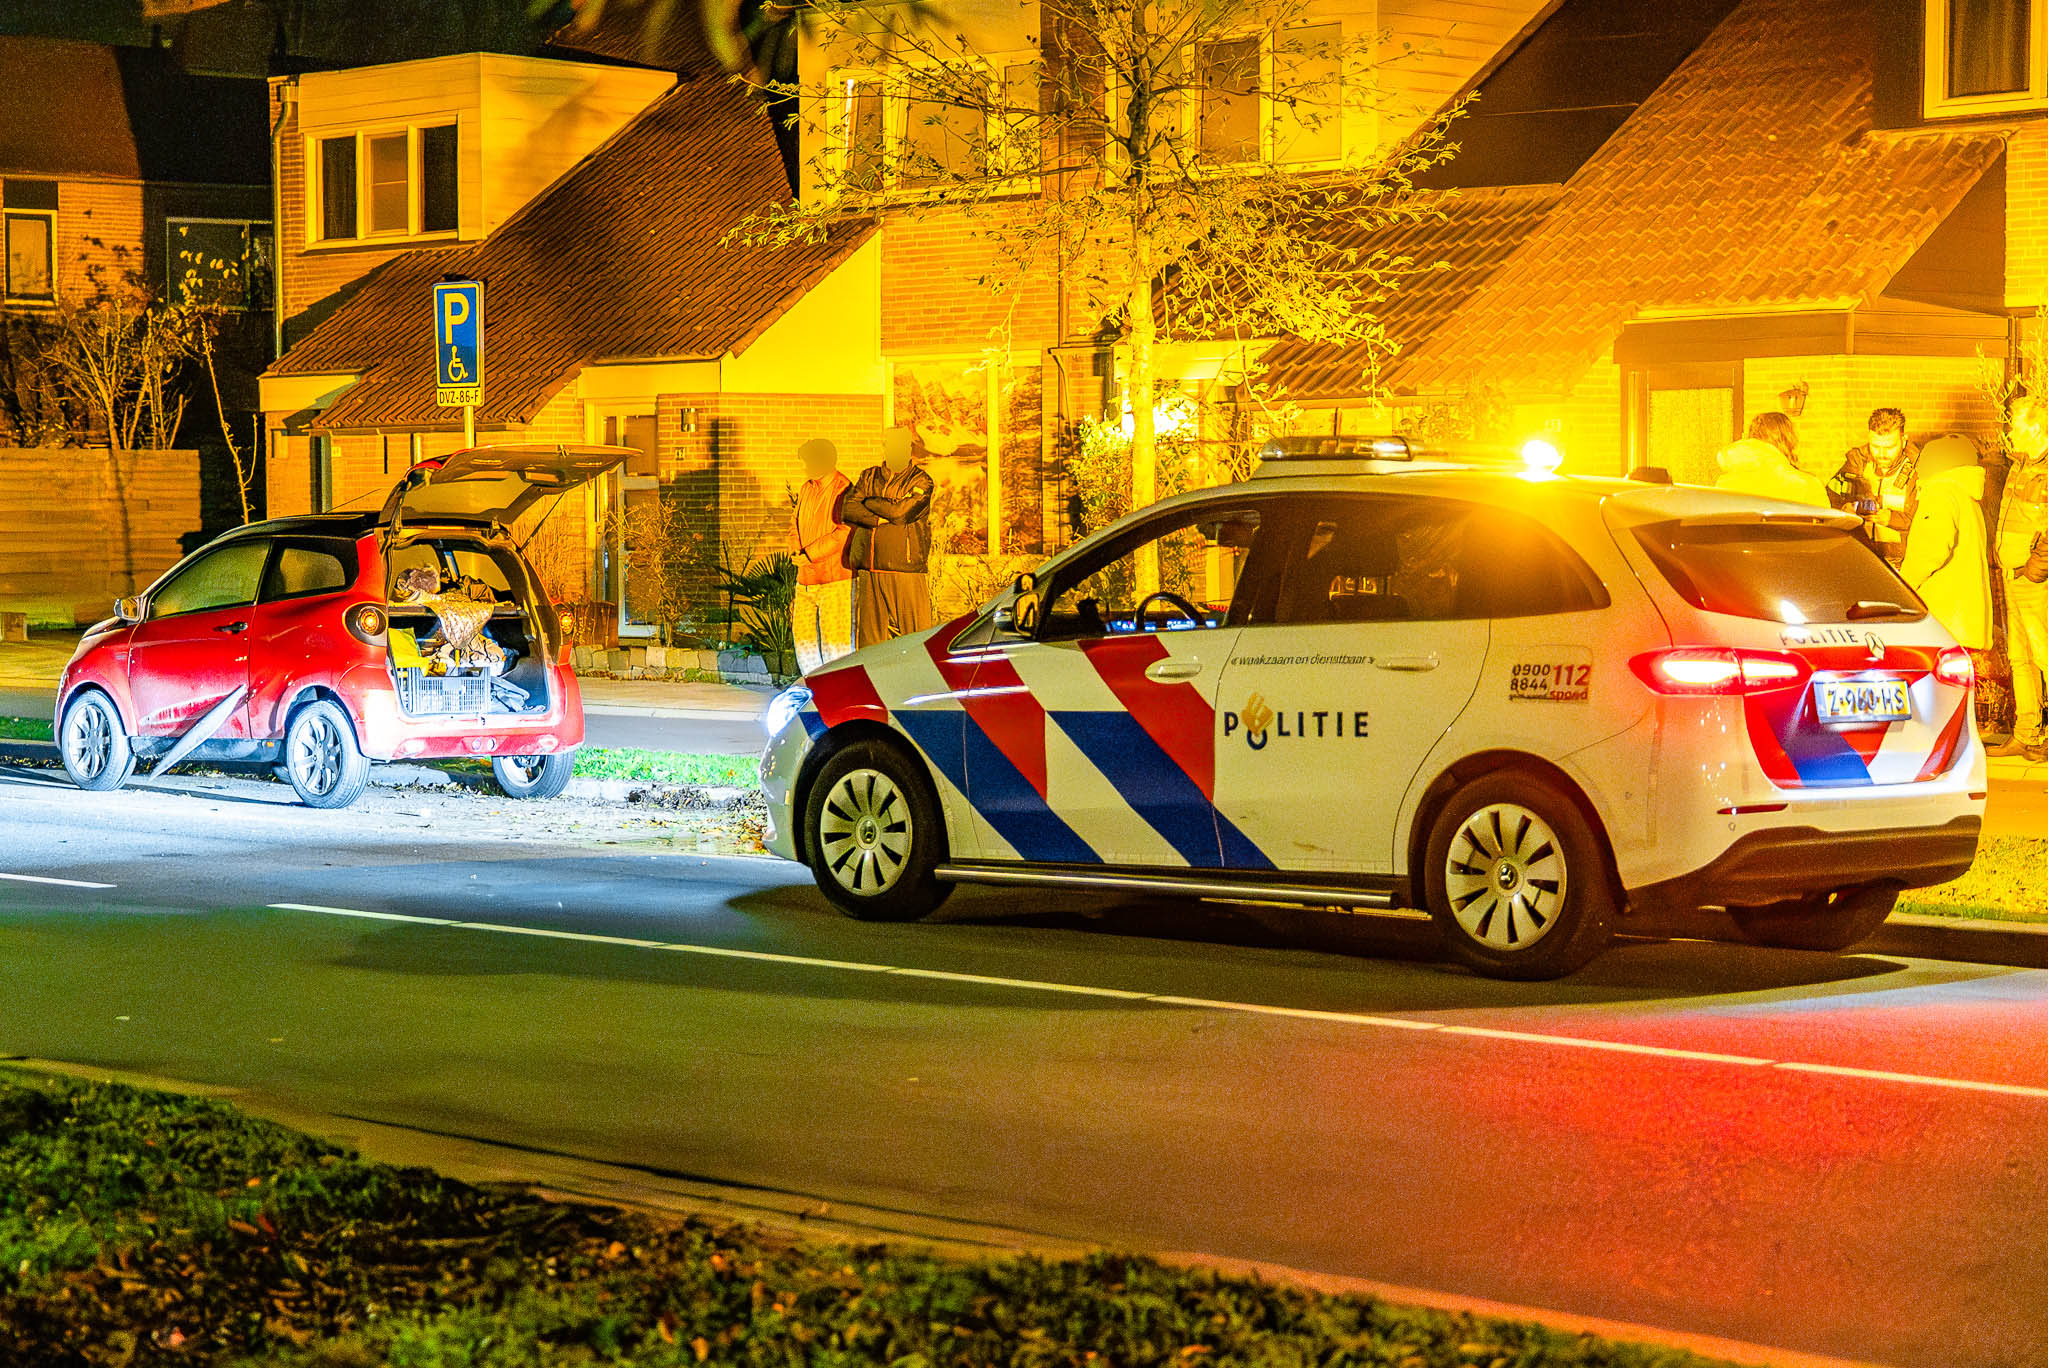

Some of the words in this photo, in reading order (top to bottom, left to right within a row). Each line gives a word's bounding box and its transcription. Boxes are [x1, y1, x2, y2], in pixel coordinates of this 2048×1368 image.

[444, 292, 470, 345] P
[439, 390, 479, 404] DVZ-86-F
[1512, 664, 1551, 676] 0900
[1553, 664, 1591, 686] 112
[1510, 678, 1548, 690] 8844
[1224, 711, 1369, 750] POLITIE
